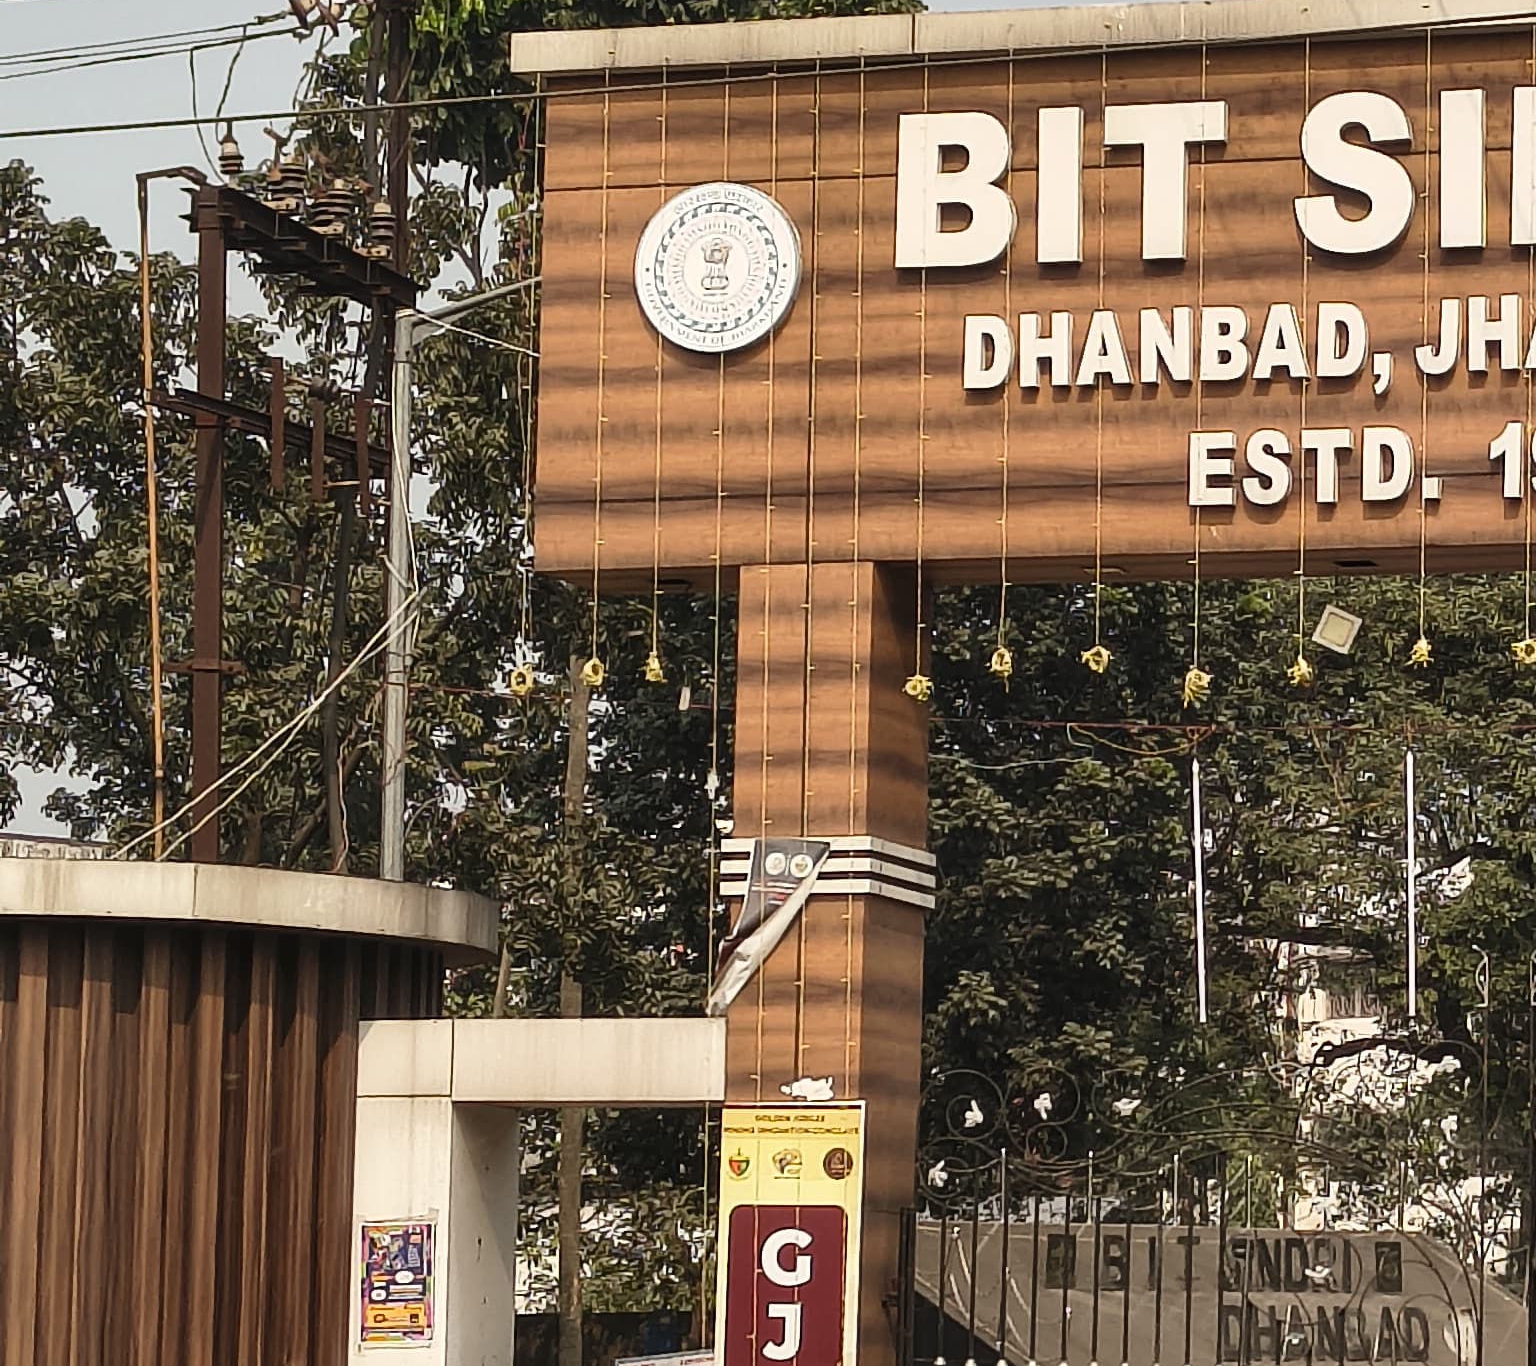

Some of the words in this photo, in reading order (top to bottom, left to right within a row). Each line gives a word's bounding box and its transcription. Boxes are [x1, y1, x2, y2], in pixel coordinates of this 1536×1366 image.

[895, 101, 1228, 268] BIT
[963, 303, 1392, 395] DHANBAD,
[1189, 427, 1440, 509] ESTD.
